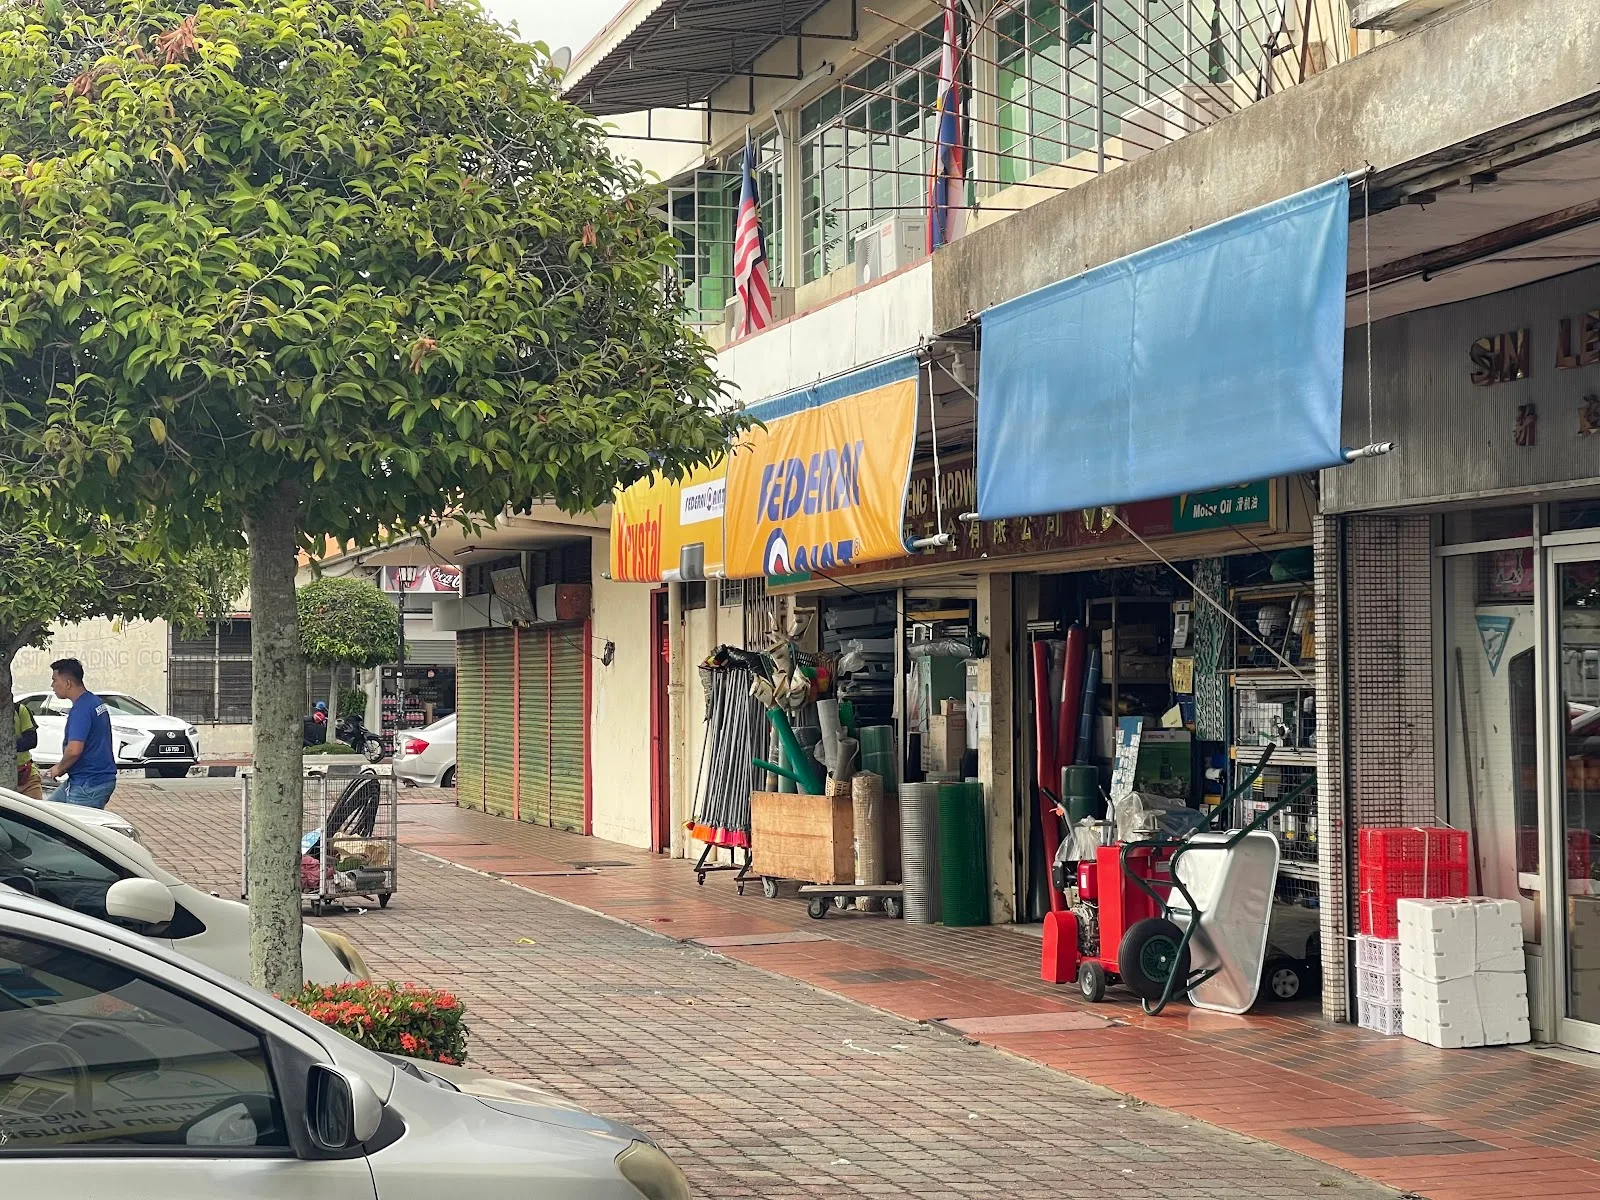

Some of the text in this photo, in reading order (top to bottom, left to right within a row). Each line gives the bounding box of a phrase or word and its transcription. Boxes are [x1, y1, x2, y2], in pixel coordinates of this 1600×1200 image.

[757, 440, 864, 524] FEDERAL
[1193, 503, 1217, 519] Motor
[1220, 499, 1232, 515] Oil
[618, 503, 662, 582] Krystal
[50, 648, 129, 669] TRADING
[138, 648, 164, 667] CO
